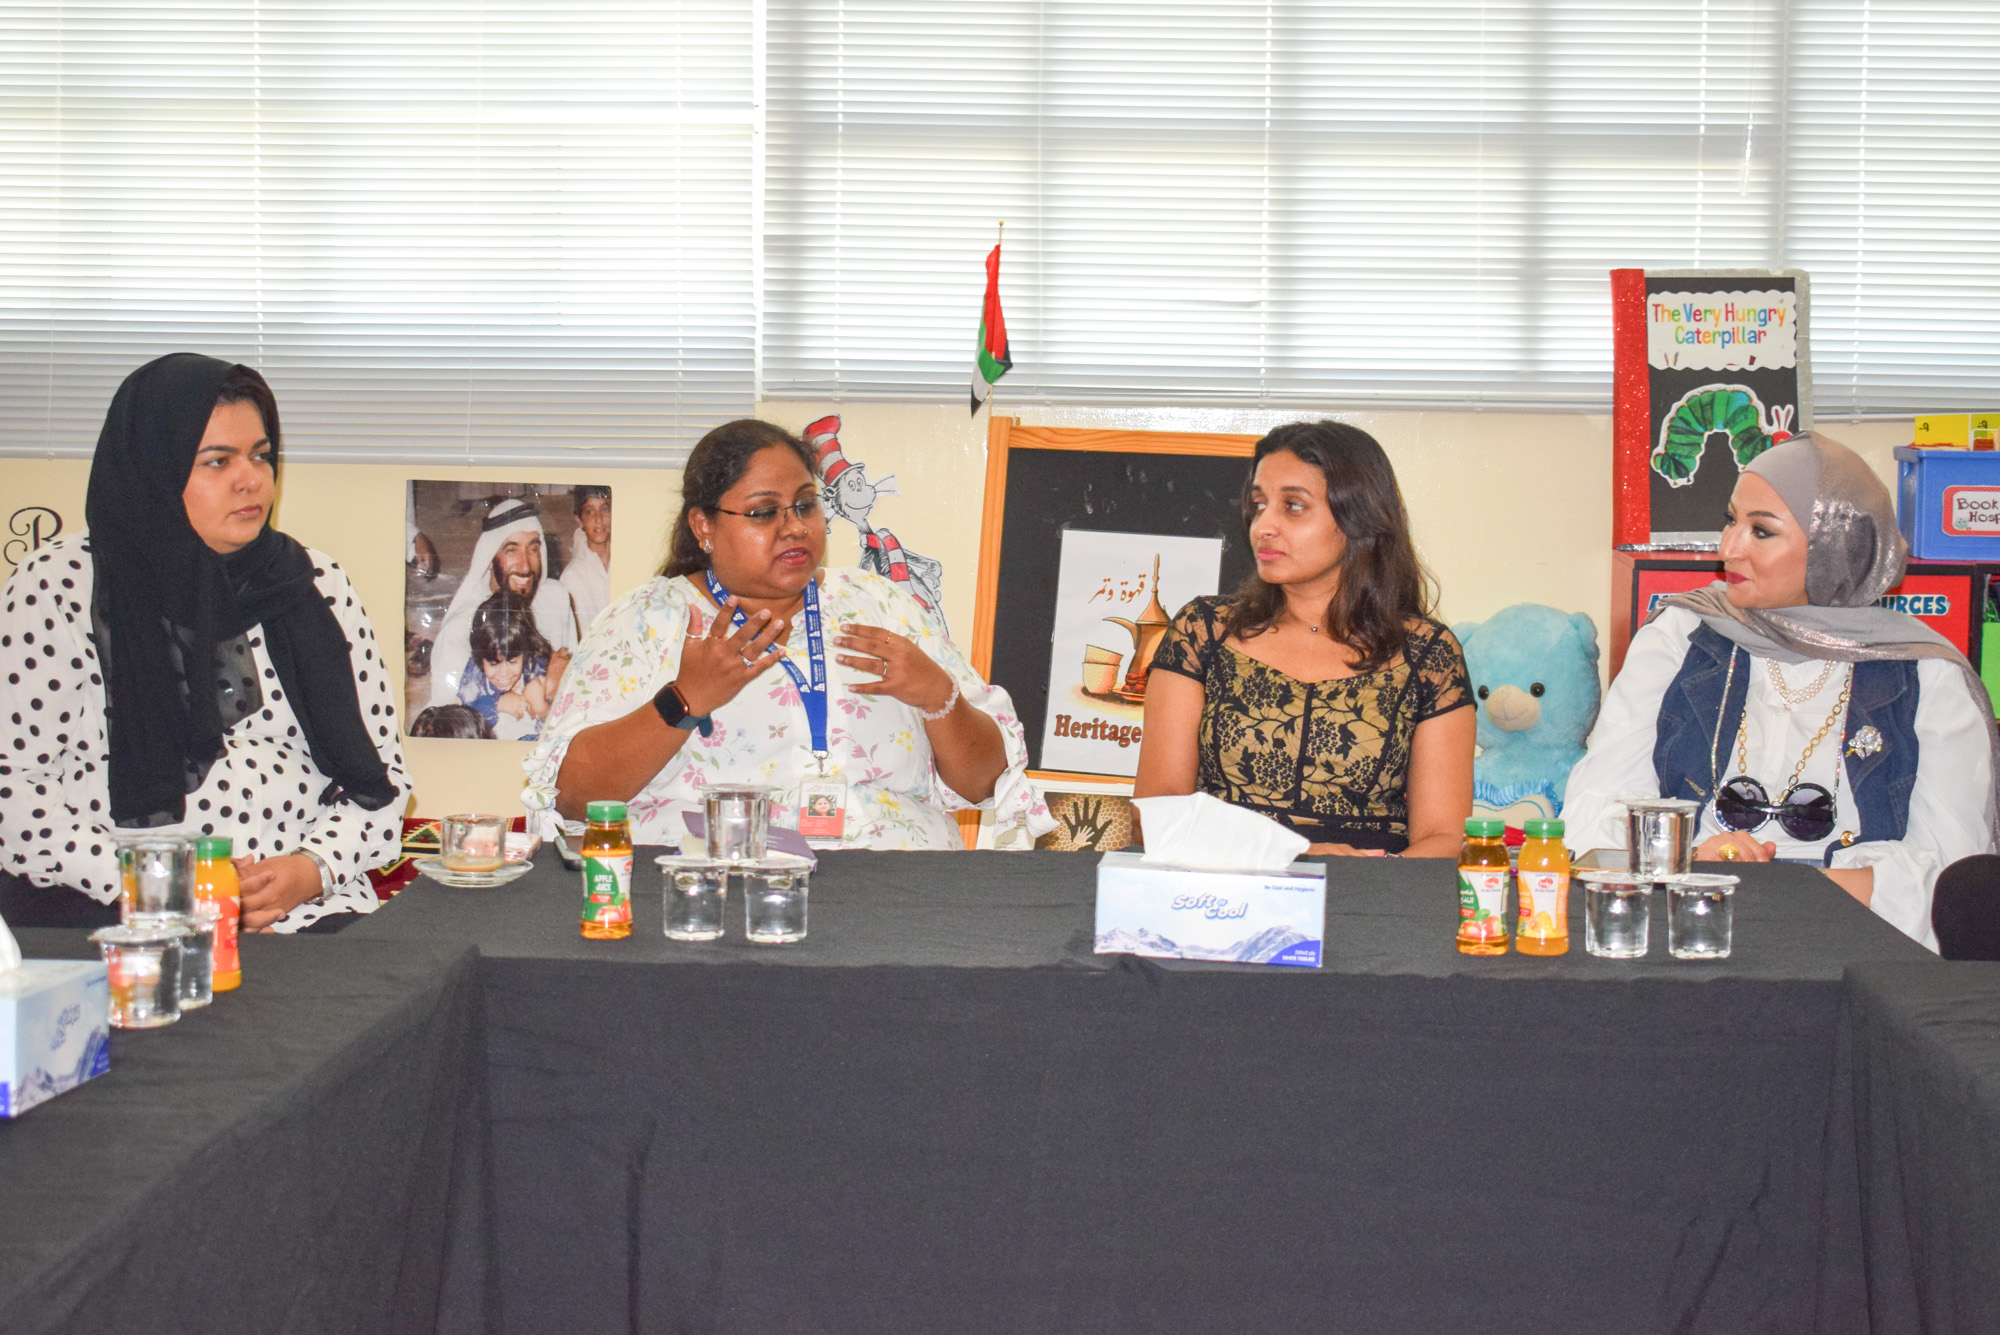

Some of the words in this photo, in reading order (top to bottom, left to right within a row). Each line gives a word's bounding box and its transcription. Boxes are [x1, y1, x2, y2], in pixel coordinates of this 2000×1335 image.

[1652, 303, 1681, 322] The
[1683, 303, 1721, 327] Very
[1725, 303, 1786, 327] Hungry
[1675, 326, 1766, 349] Caterpillar
[1957, 498, 1999, 510] Book
[1088, 578, 1114, 604] وتمر
[1120, 574, 1147, 603] قهوة
[1869, 596, 1947, 614] URCES
[1054, 714, 1142, 748] Heritage
[1171, 893, 1217, 910] Soft
[1205, 901, 1248, 920] Cool
